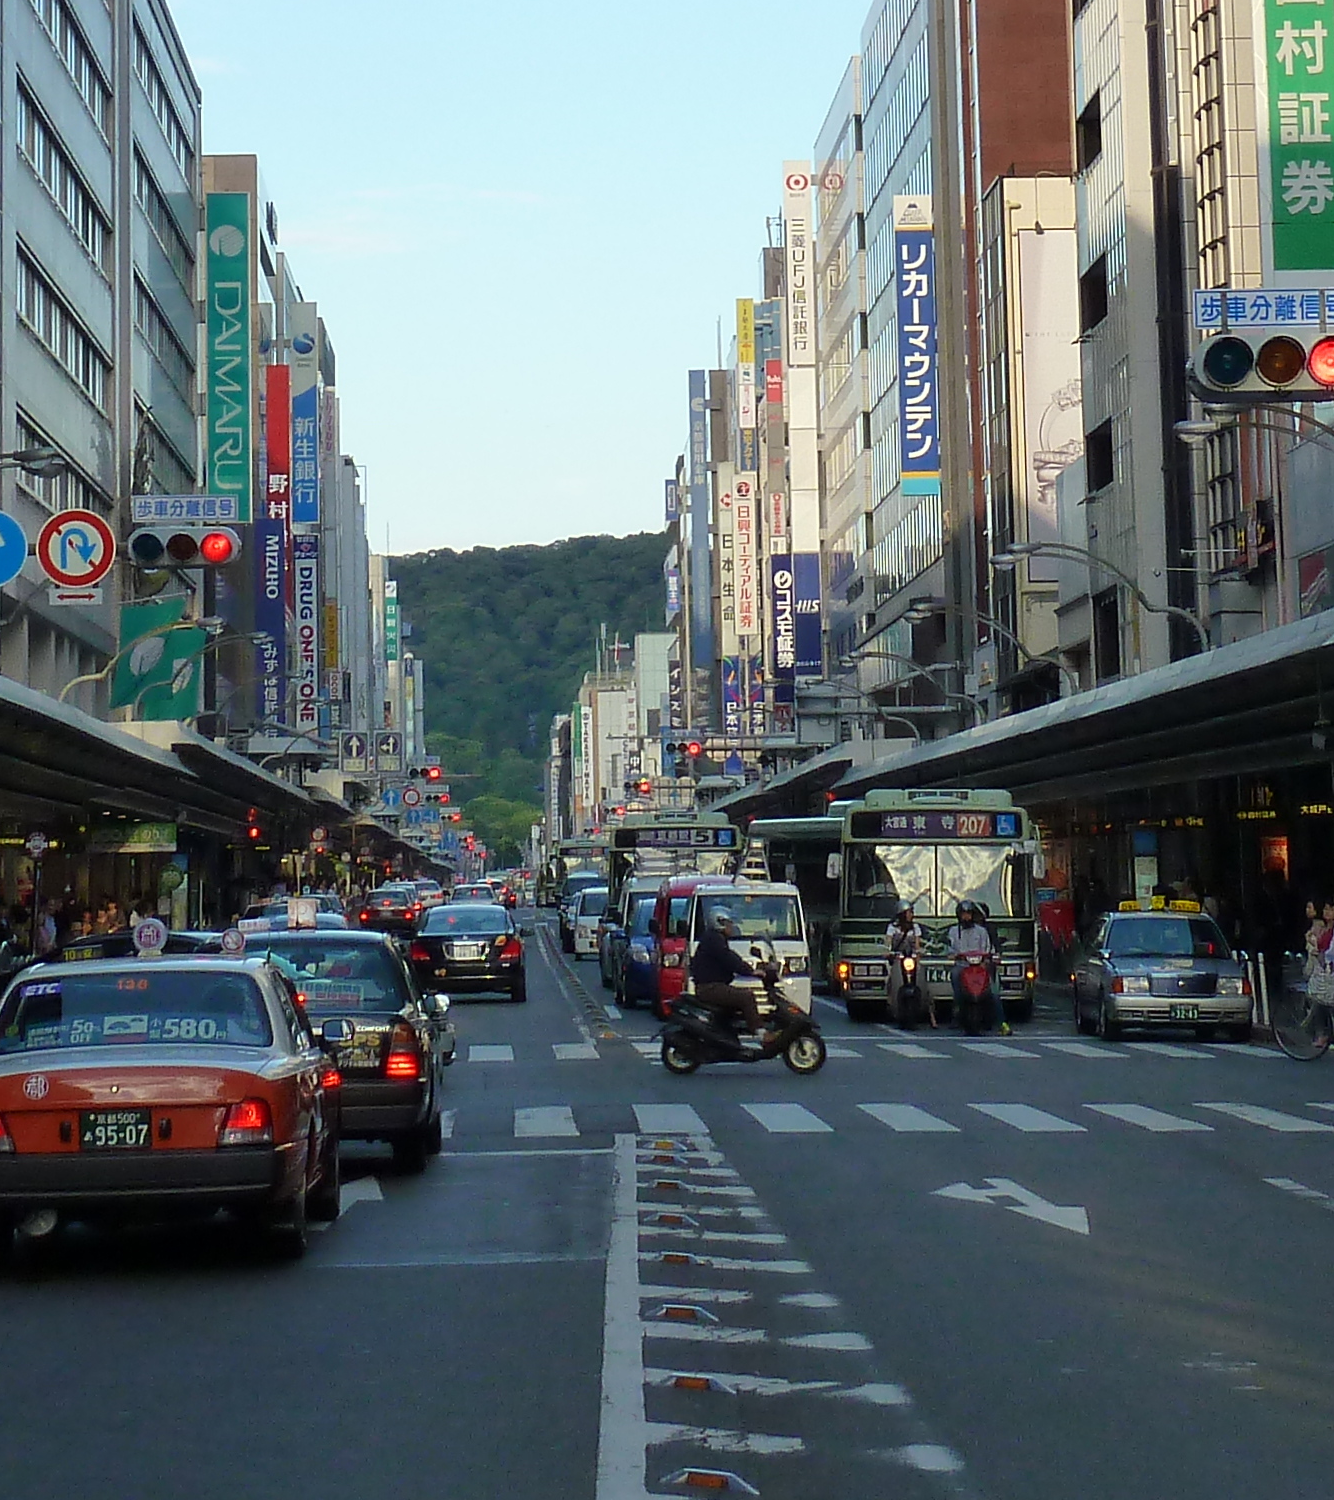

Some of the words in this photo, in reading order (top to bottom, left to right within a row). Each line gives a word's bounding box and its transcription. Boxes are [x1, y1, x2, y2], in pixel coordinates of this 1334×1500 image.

[790, 218, 808, 351] 三菱UFJ信託銀行
[900, 242, 936, 460] リカーマウンテン
[214, 281, 244, 491] DAIMARU
[293, 416, 317, 504] 新生銀行
[137, 501, 235, 518] 歩車分離信号
[265, 534, 280, 600] MIZUHO
[299, 566, 314, 620] DRUG
[737, 505, 753, 629] 日興コーディアル証券
[776, 589, 795, 668] コスモ証券
[582, 722, 591, 800] TAKASHIMAYA
[697, 830, 711, 844] 5
[959, 816, 987, 836] 207
[24, 982, 60, 996] ETC
[163, 1018, 215, 1040] 580
[95, 1124, 149, 1146] 95-07
